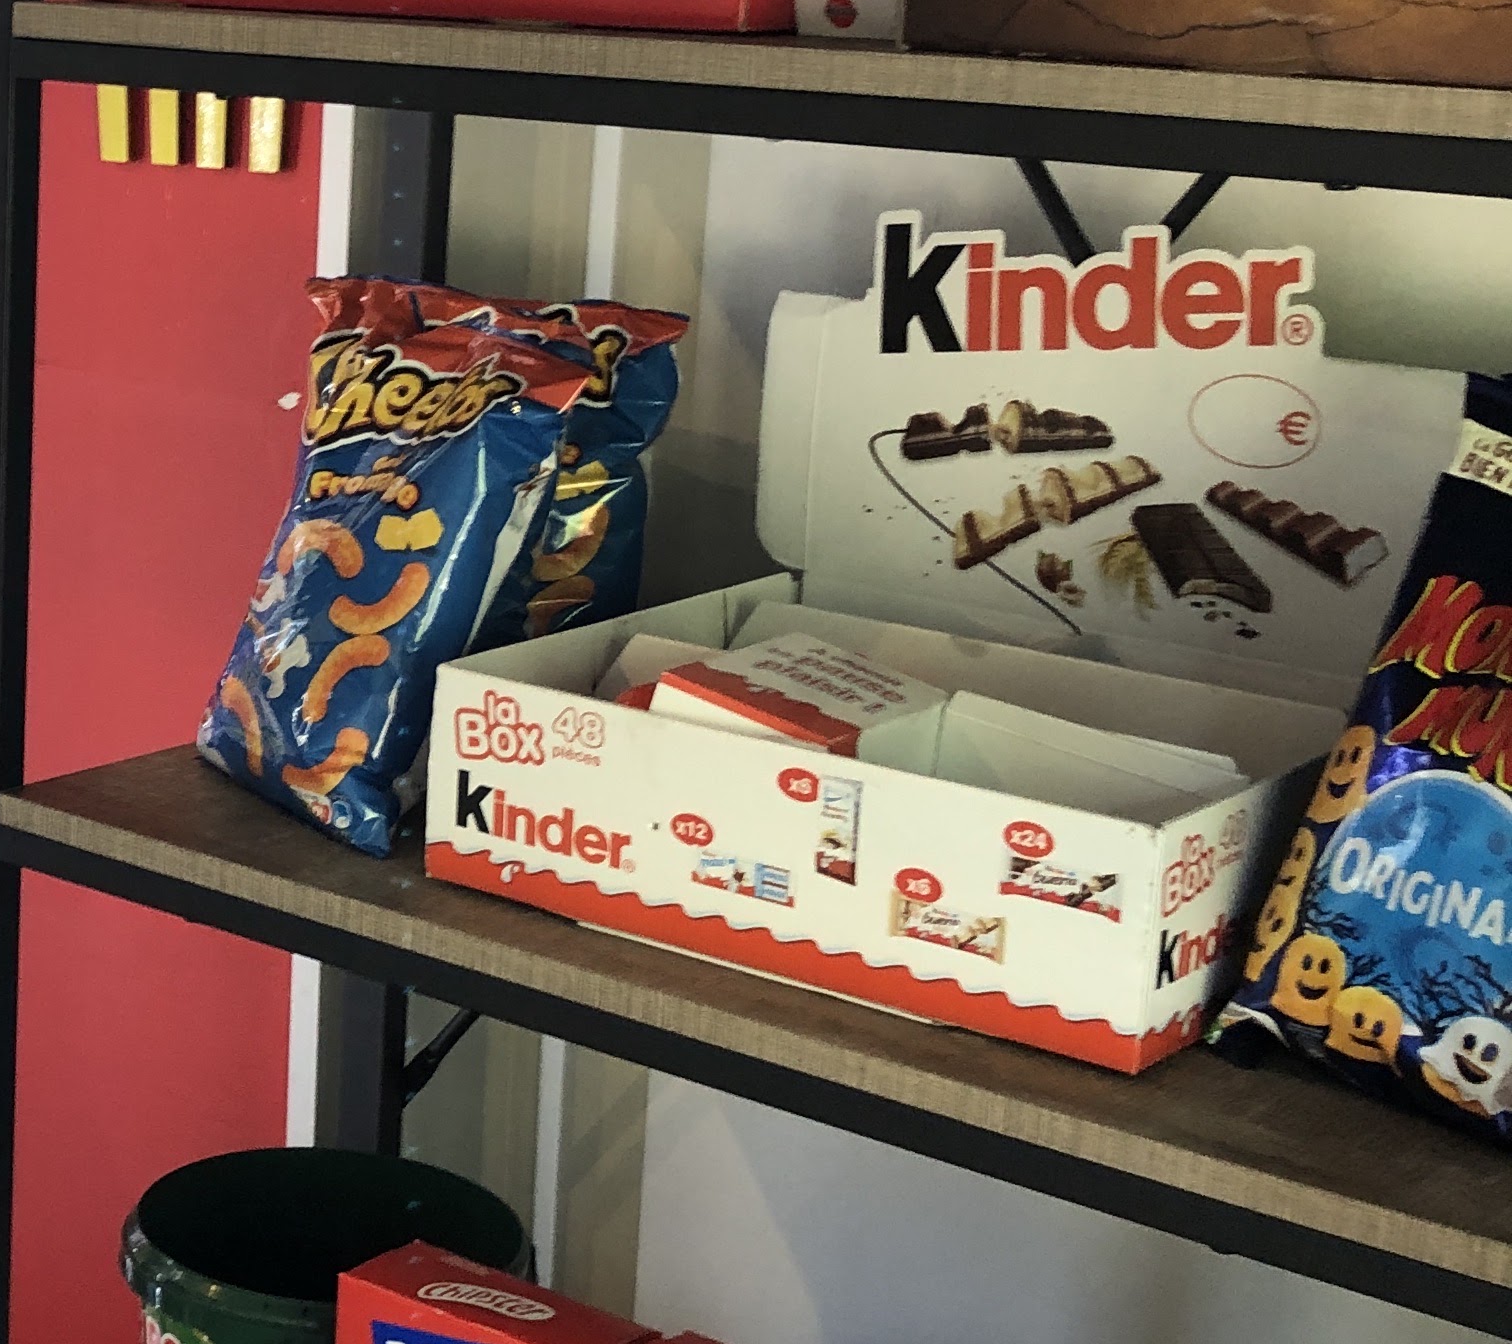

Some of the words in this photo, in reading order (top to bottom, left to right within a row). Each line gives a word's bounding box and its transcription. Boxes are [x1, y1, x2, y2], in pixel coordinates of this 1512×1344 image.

[1275, 410, 1313, 446] €
[483, 689, 520, 726] la
[551, 706, 606, 751] 48
[1328, 836, 1512, 947] ORIGINA
